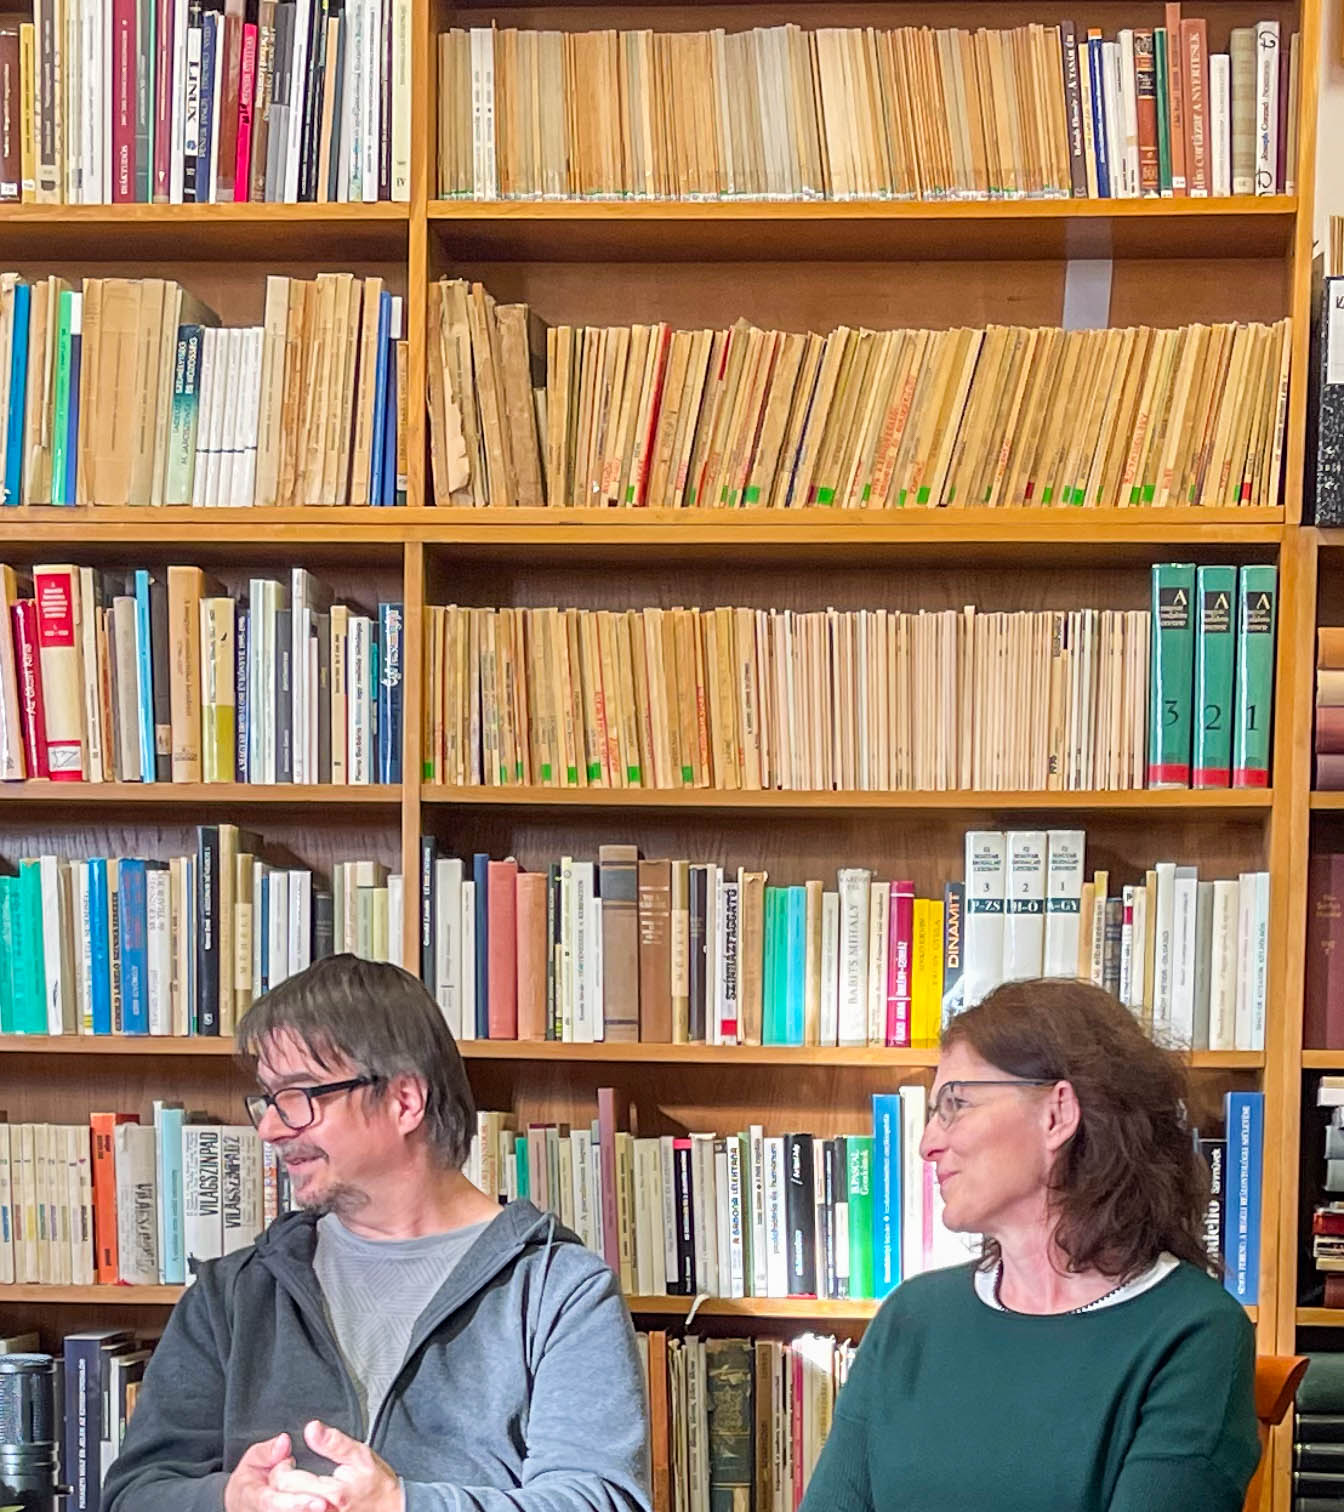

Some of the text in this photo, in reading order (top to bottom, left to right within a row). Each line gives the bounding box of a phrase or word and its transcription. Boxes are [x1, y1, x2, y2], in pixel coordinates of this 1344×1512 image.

[1189, 33, 1202, 102] NYERTESEK
[187, 60, 201, 122] LINUX
[1260, 103, 1269, 132] Conrad
[1260, 134, 1270, 161] Joseph
[1164, 699, 1179, 727] 3
[1205, 704, 1221, 731] 2
[1247, 704, 1259, 731] 1
[983, 882, 990, 893] 3
[1022, 882, 1029, 893] 2
[1059, 881, 1065, 891] 1
[724, 888, 737, 1000] SZÍNHÁZFAGGATÓ
[947, 892, 960, 970] DINAMIT
[848, 959, 859, 1005] BABITS
